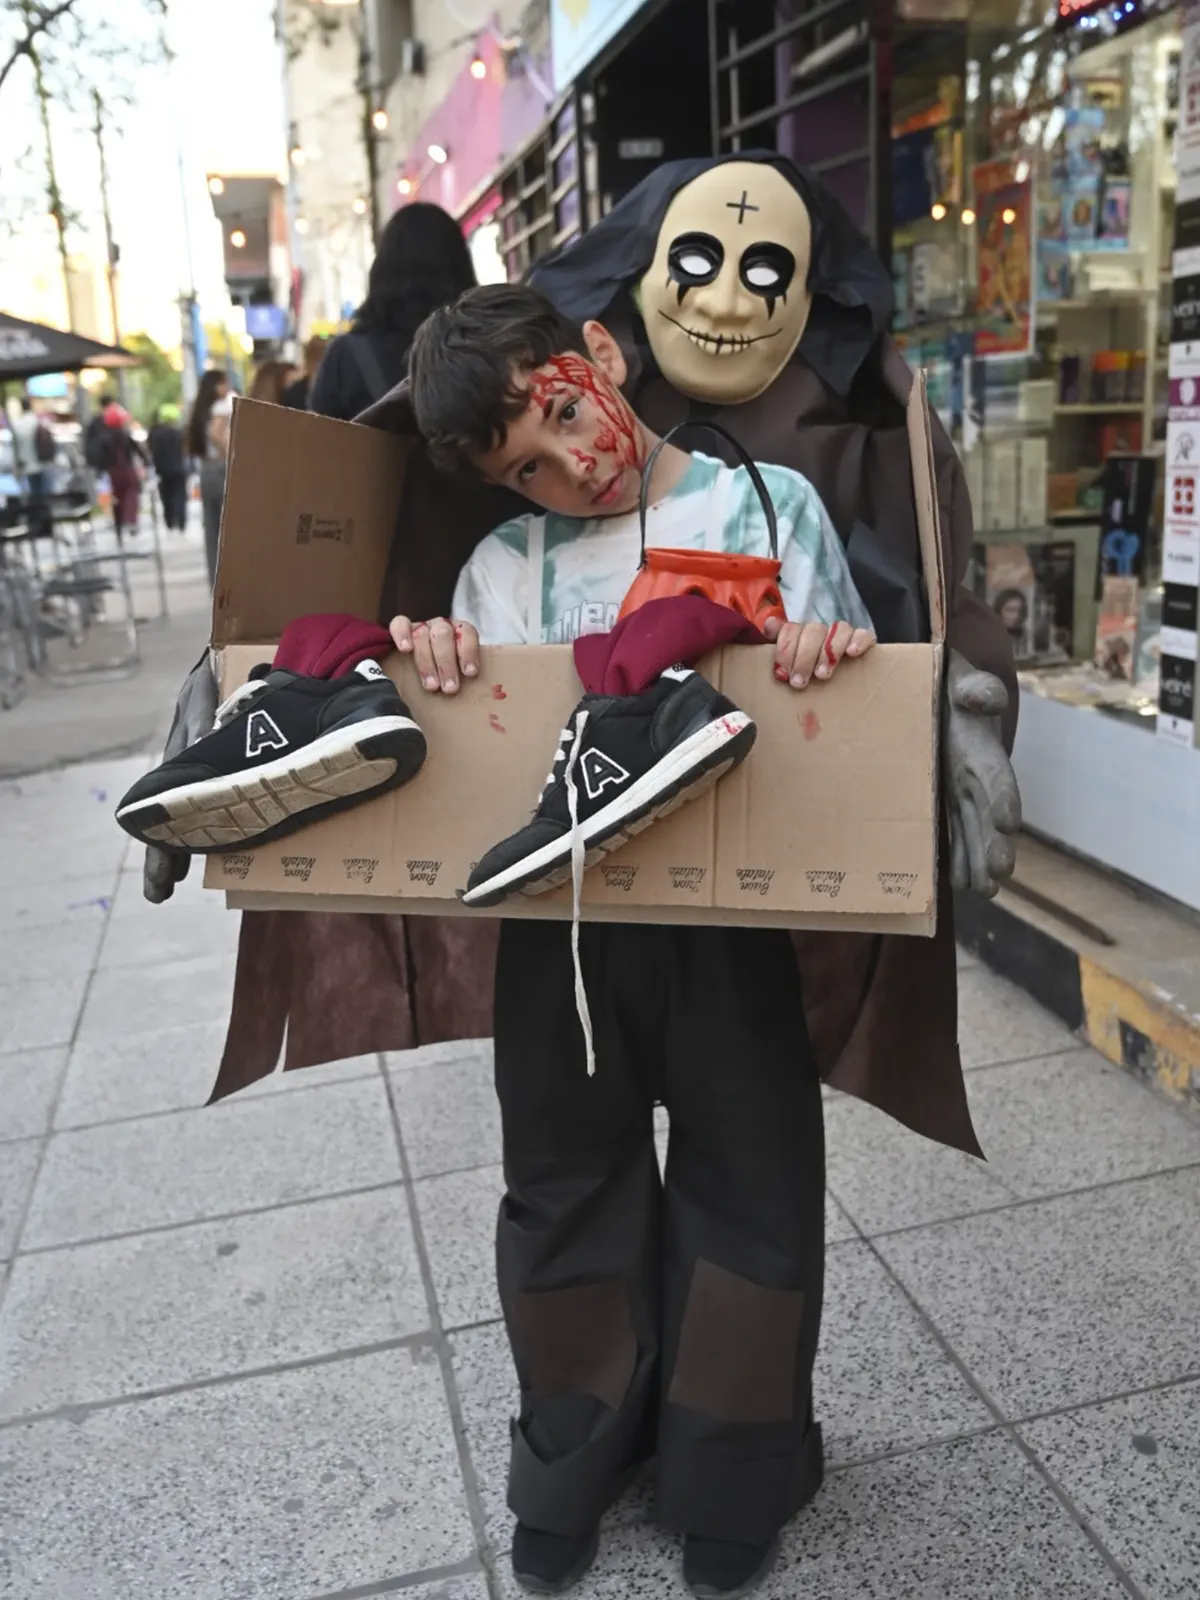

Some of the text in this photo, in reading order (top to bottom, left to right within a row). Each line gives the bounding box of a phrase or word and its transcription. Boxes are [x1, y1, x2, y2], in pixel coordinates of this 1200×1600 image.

[246, 709, 289, 757] A
[580, 747, 631, 799] A
[280, 856, 317, 869] Natale
[406, 860, 442, 873] Natale
[223, 867, 250, 879] Buon
[284, 869, 311, 882] Buon
[346, 870, 374, 884] Bn
[600, 865, 640, 878] Natale
[668, 867, 707, 881] Natale
[735, 869, 775, 882] Natale
[804, 870, 847, 884] Natale
[410, 872, 437, 886] Buon
[605, 879, 634, 892] Buon
[739, 882, 769, 896] Buon
[809, 884, 840, 898] Buon
